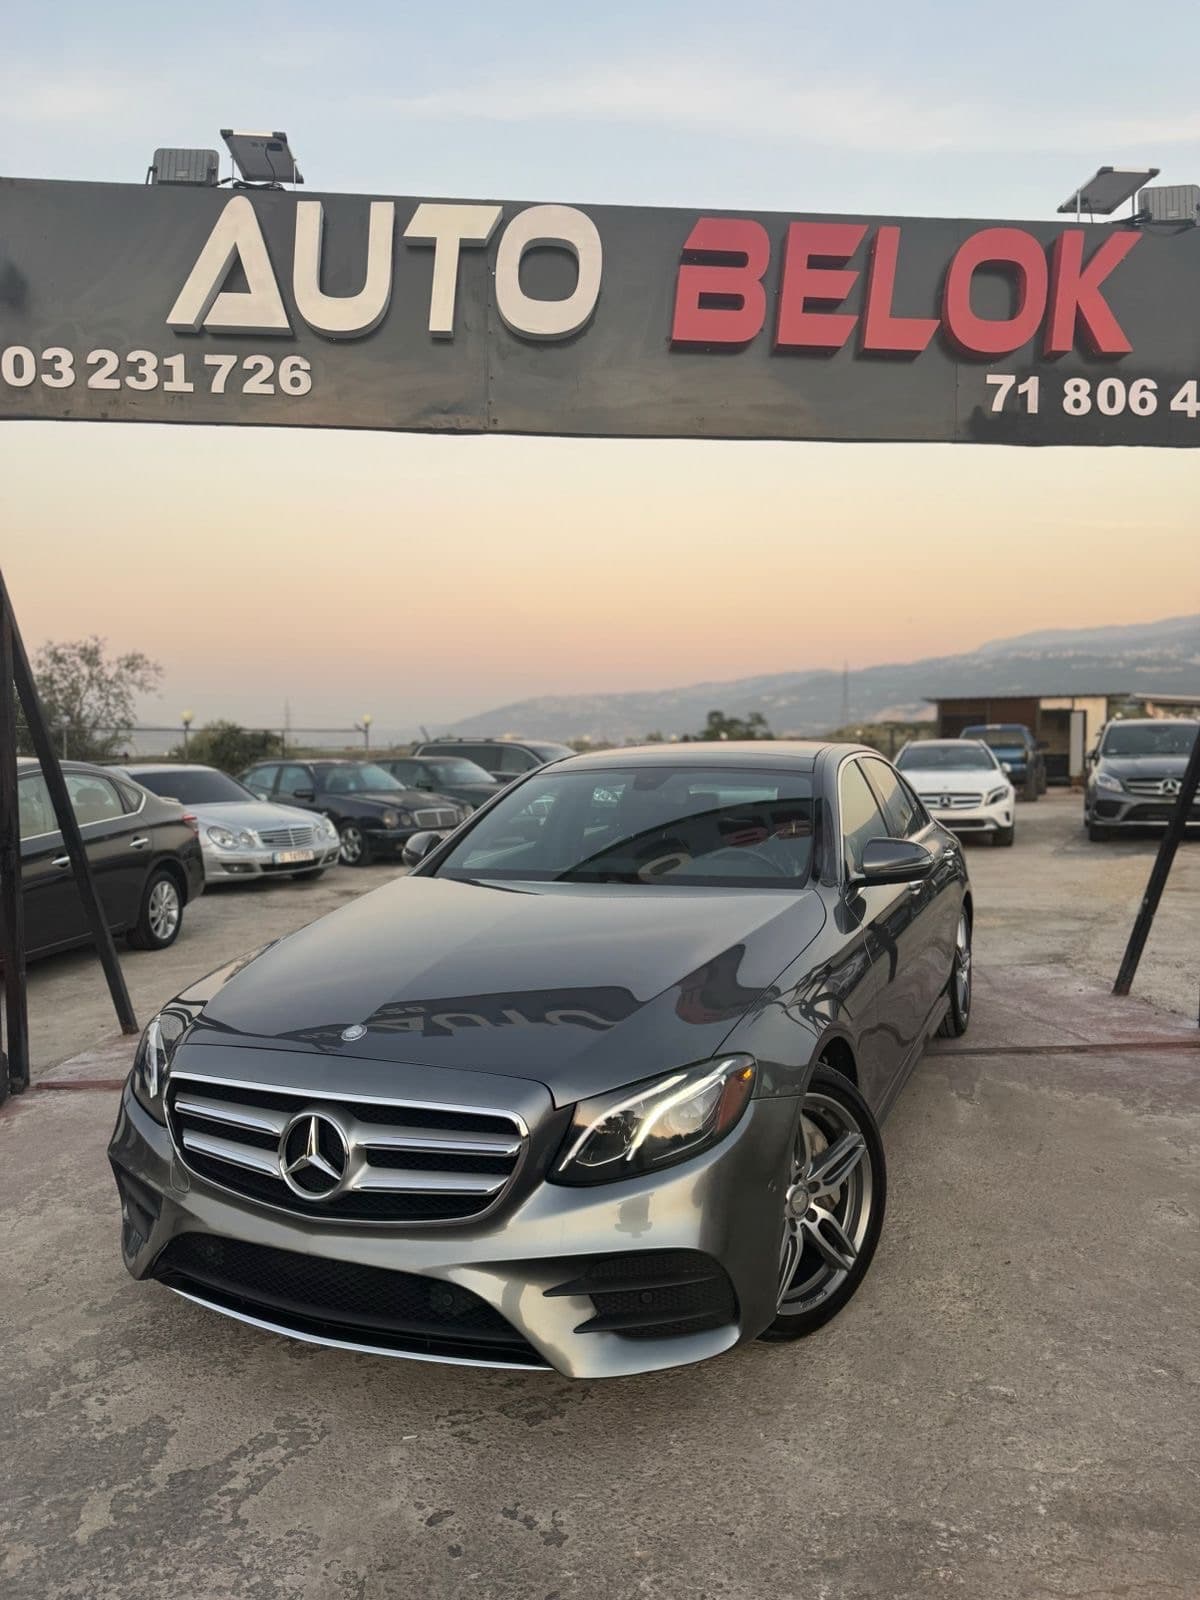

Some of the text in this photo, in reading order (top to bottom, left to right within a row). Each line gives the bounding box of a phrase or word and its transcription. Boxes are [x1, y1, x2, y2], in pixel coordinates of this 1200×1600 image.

[167, 195, 1142, 357] AUTO BELOK
[1, 346, 312, 396] 03 231 726
[986, 374, 1200, 418] 71 806 4
